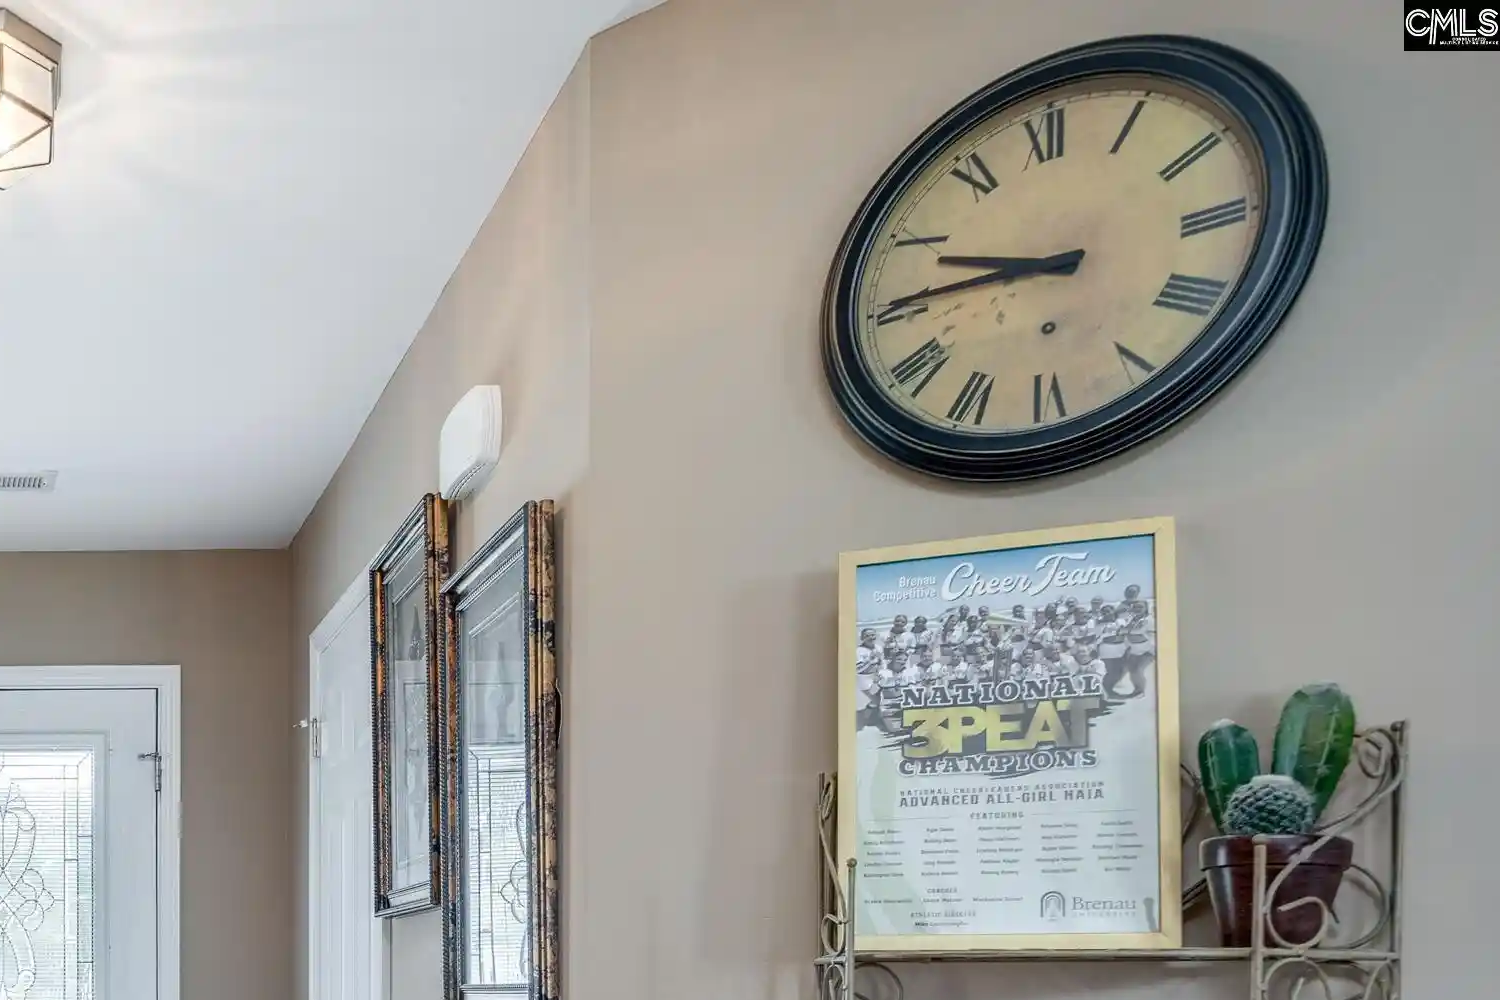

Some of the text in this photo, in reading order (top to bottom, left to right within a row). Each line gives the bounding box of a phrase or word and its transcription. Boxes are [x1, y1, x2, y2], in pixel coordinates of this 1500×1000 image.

[899, 575, 937, 589] Brenau
[941, 551, 1116, 601] Cheer Team
[873, 587, 938, 604] Competitive
[900, 674, 1103, 708] NATIONAL
[902, 700, 1101, 759] 3PEAT
[898, 749, 1099, 777] CHAMPIONS
[900, 794, 980, 808] ADVANCED
[986, 791, 1057, 805] ALL-GIRL
[1071, 895, 1137, 911] Brenau
